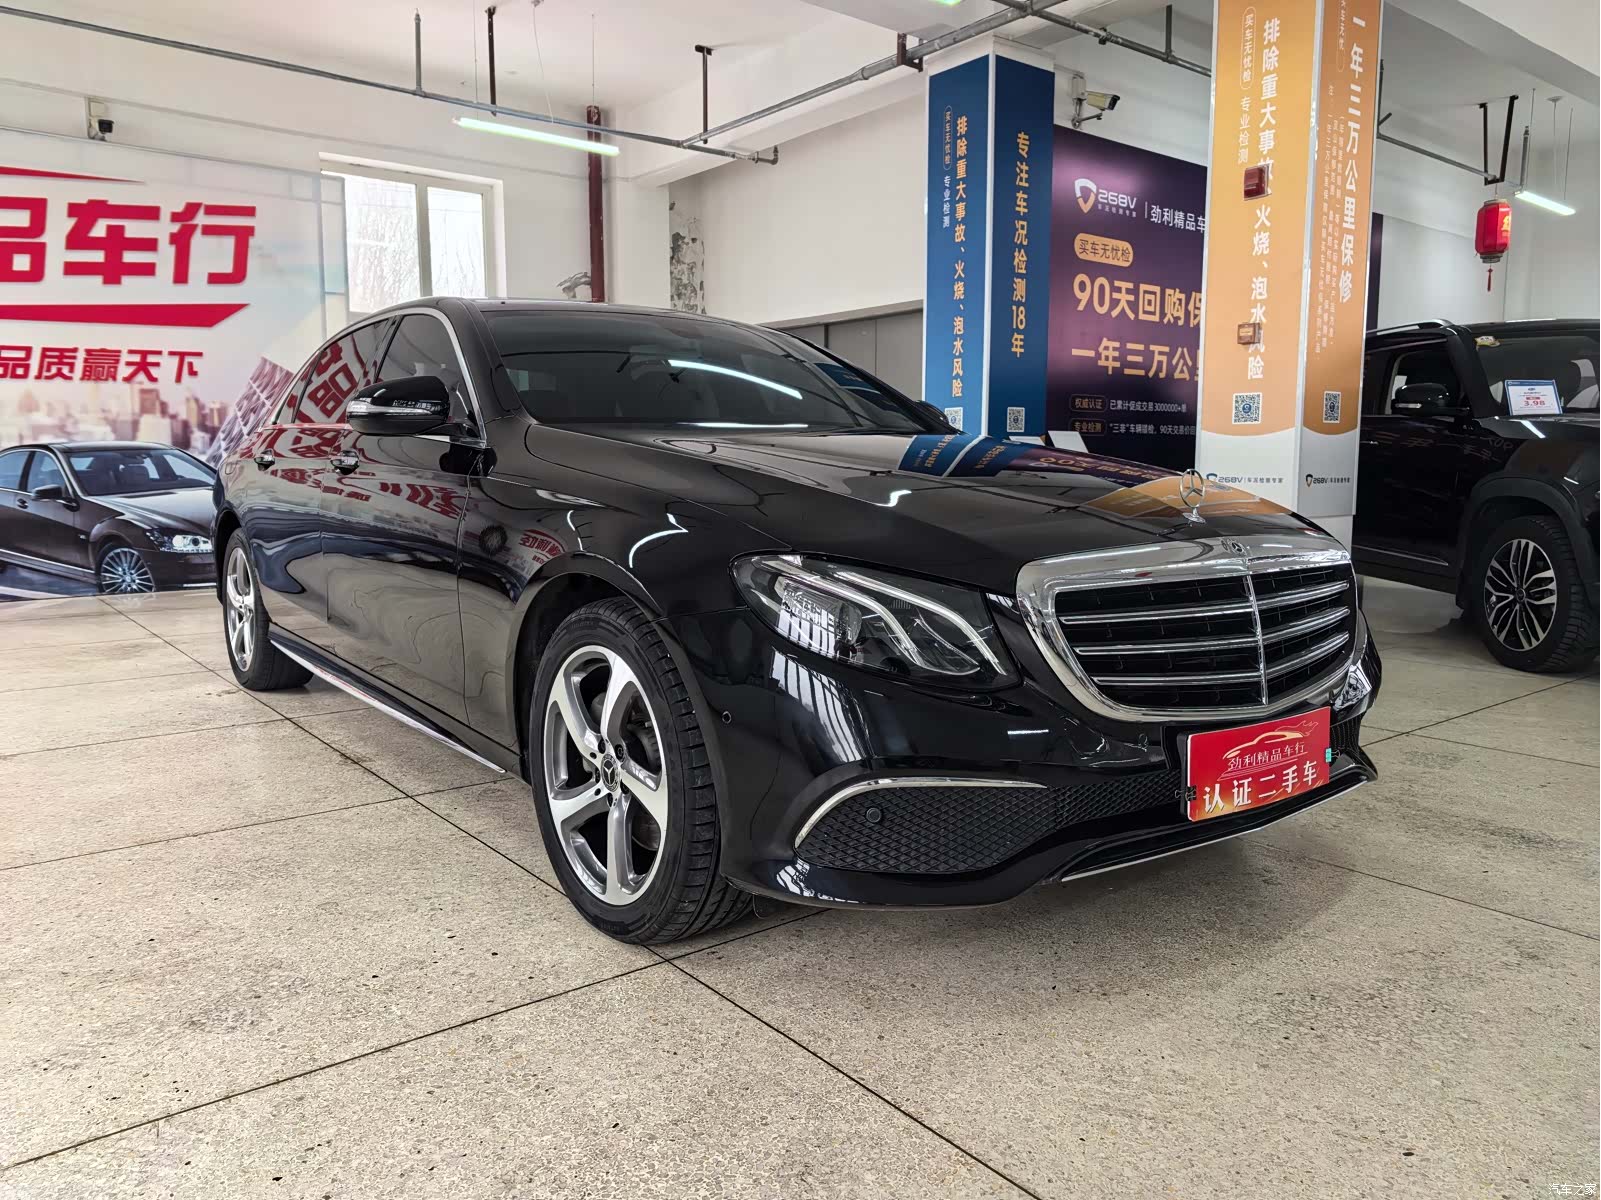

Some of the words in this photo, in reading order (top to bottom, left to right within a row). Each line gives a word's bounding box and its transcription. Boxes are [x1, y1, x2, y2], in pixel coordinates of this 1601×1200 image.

[1242, 13, 1255, 83] 买车无忧检
[1238, 97, 1251, 164] 专业检测
[1339, 16, 1366, 303] 一年三万公里保修
[1098, 189, 1137, 209] 268V
[952, 115, 968, 398] 排除重大事故、火烧、泡水风险
[1011, 131, 1031, 358] 专注车况检测18年
[1079, 239, 1131, 263] 买车无忧检
[0, 344, 203, 383] 品质赢天下
[1071, 337, 1200, 382] 一年三万公
[1073, 421, 1102, 433] 专业检测
[1218, 476, 1244, 484] 268V
[1227, 742, 1306, 772] 劲利精品车行
[1203, 760, 1318, 814] 认证二手车
